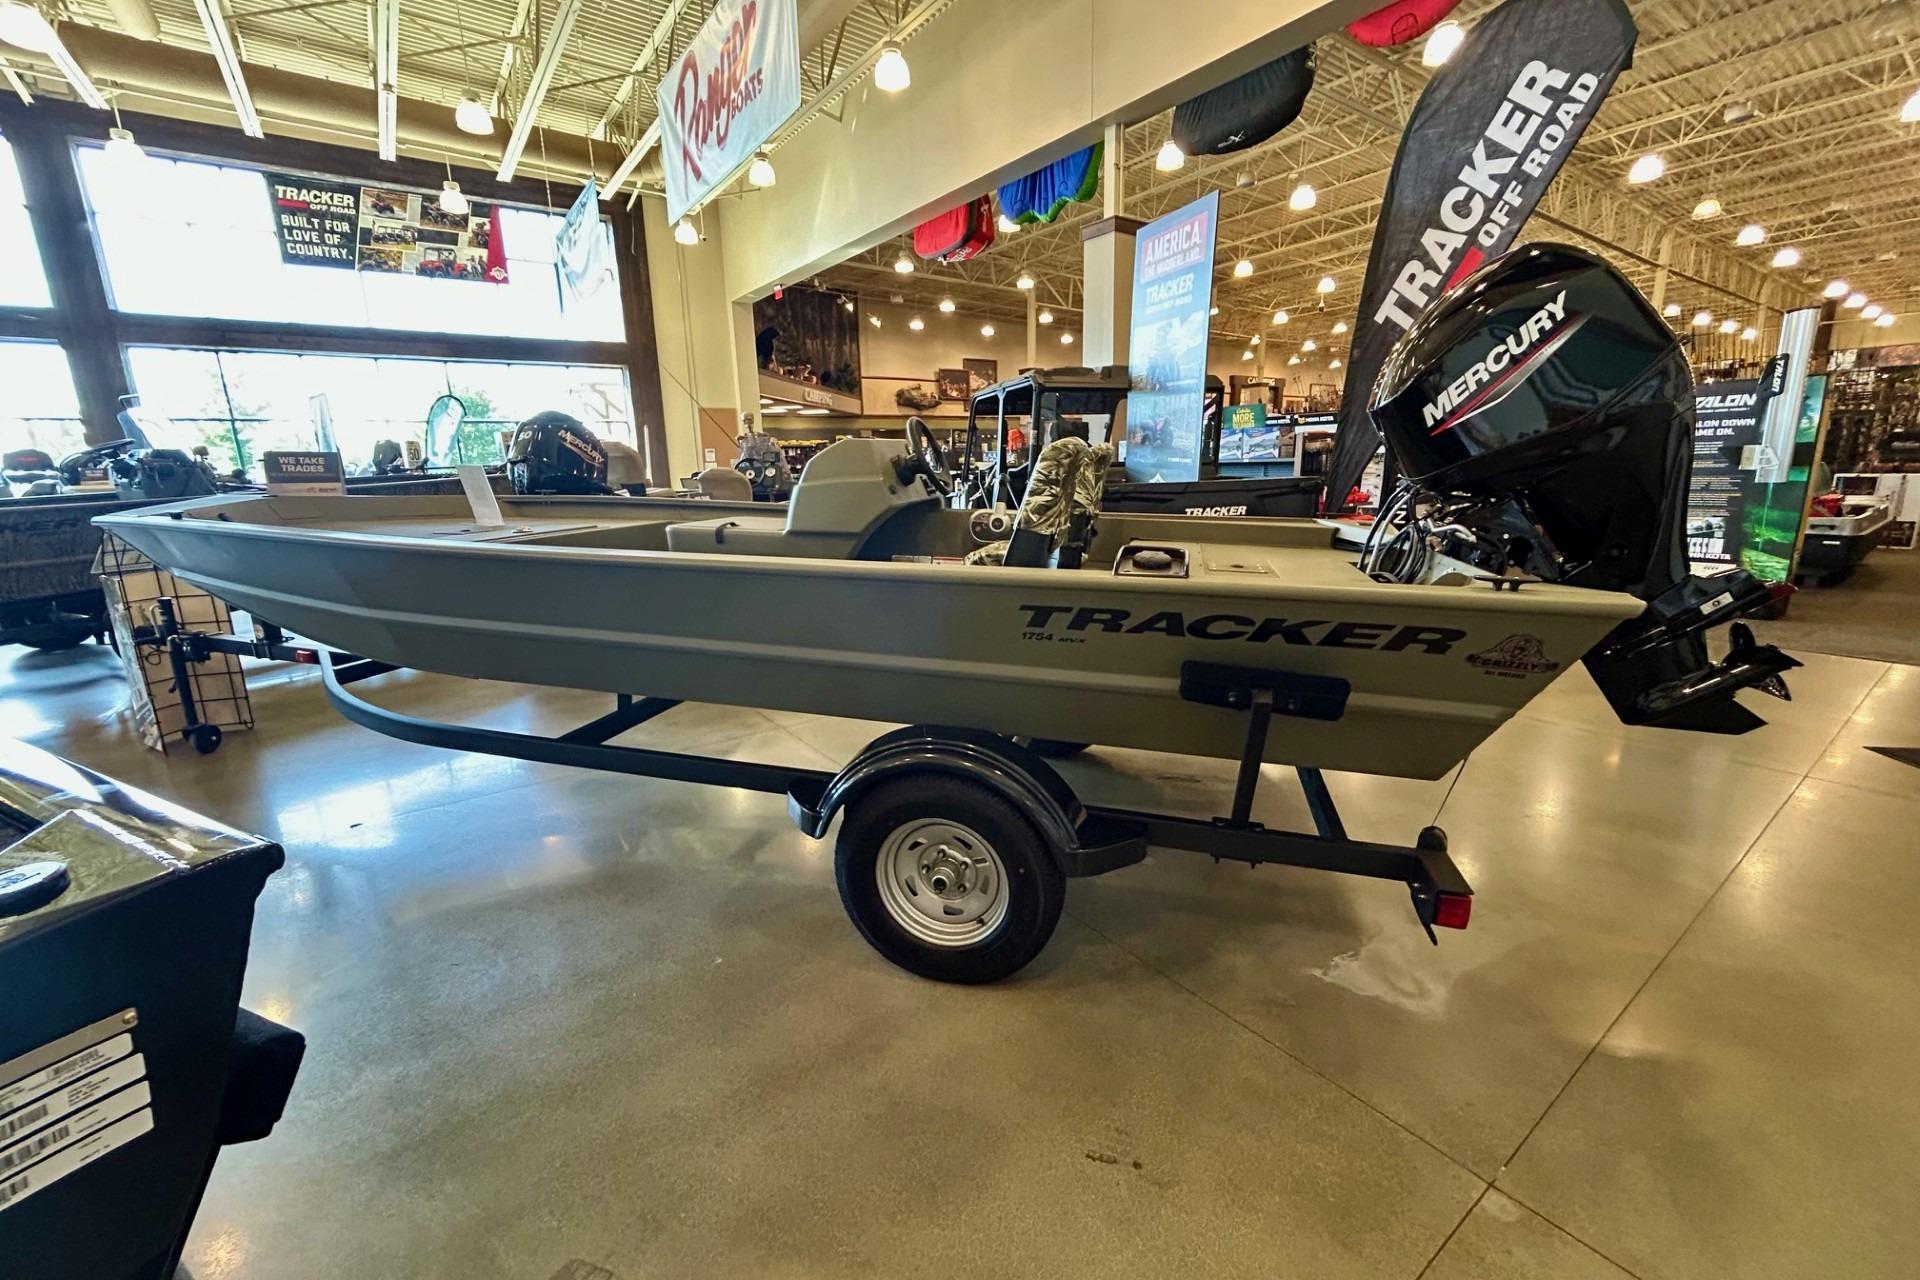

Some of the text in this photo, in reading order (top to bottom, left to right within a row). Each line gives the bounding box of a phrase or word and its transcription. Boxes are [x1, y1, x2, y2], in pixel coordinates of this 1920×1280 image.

[731, 67, 764, 121] BOATS
[1478, 72, 1600, 248] OFF ROAD
[275, 184, 355, 208] TRACKER
[1374, 60, 1571, 332] TRACKER
[309, 203, 356, 215] OFF ROAD
[281, 214, 351, 234] BUILT FOR
[284, 229, 342, 245] LOVE OF
[287, 243, 354, 261] COUNTRY.
[1146, 272, 1194, 305] TRACKER
[1422, 289, 1567, 428] MERCURY
[1232, 412, 1255, 424] MORE
[1721, 418, 1756, 427] DOWN
[278, 456, 326, 465] WE TAKE
[281, 464, 325, 473] TRADES
[1184, 505, 1247, 517] TRACKER
[1019, 604, 1468, 656] TRACKER
[1022, 632, 1054, 641] 1754
